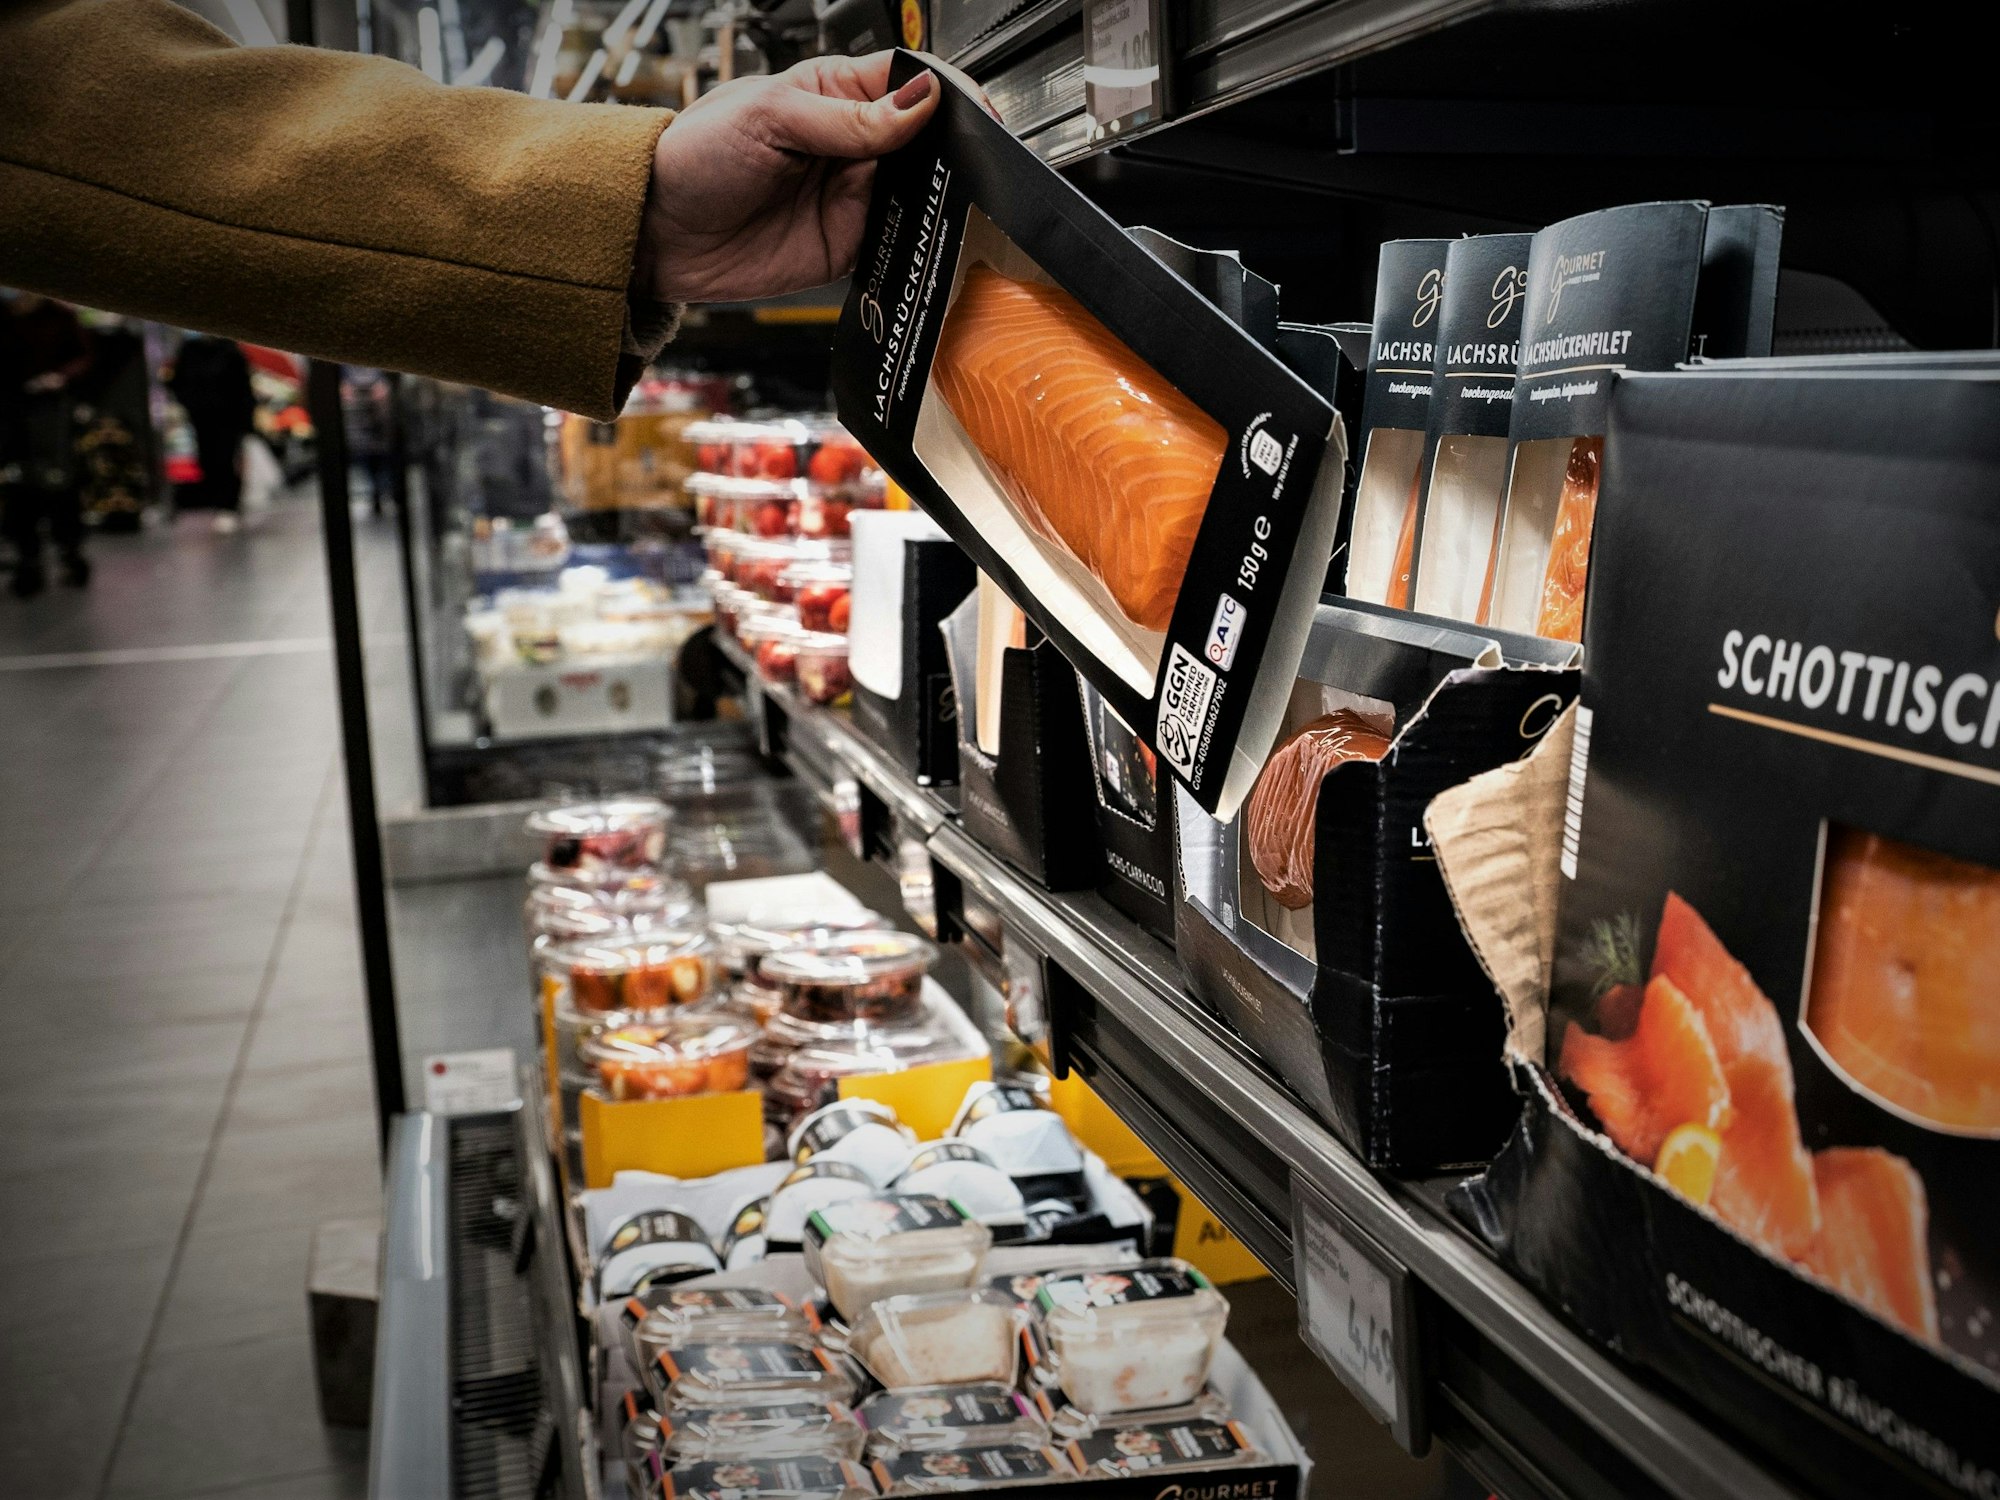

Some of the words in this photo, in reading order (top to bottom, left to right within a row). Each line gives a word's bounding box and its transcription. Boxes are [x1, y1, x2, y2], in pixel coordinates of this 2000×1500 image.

[860, 194, 899, 344] GOURMET
[873, 158, 945, 423] LACHSRÜCKENFILET
[1546, 250, 1606, 324] GOURMET
[1376, 341, 1438, 363] LACHSR
[1523, 330, 1633, 366] LACHSRÜCKENFILET
[1237, 555, 1260, 591] 150
[1250, 541, 1268, 561] g
[1166, 653, 1190, 709] GGN
[1179, 665, 1198, 718] CERTIFIED
[1186, 671, 1206, 724] FARMING
[1197, 678, 1228, 762] 4056186627902
[1192, 764, 1204, 791] CoC:
[1665, 1271, 1827, 1399] SCHOTTISCHER
